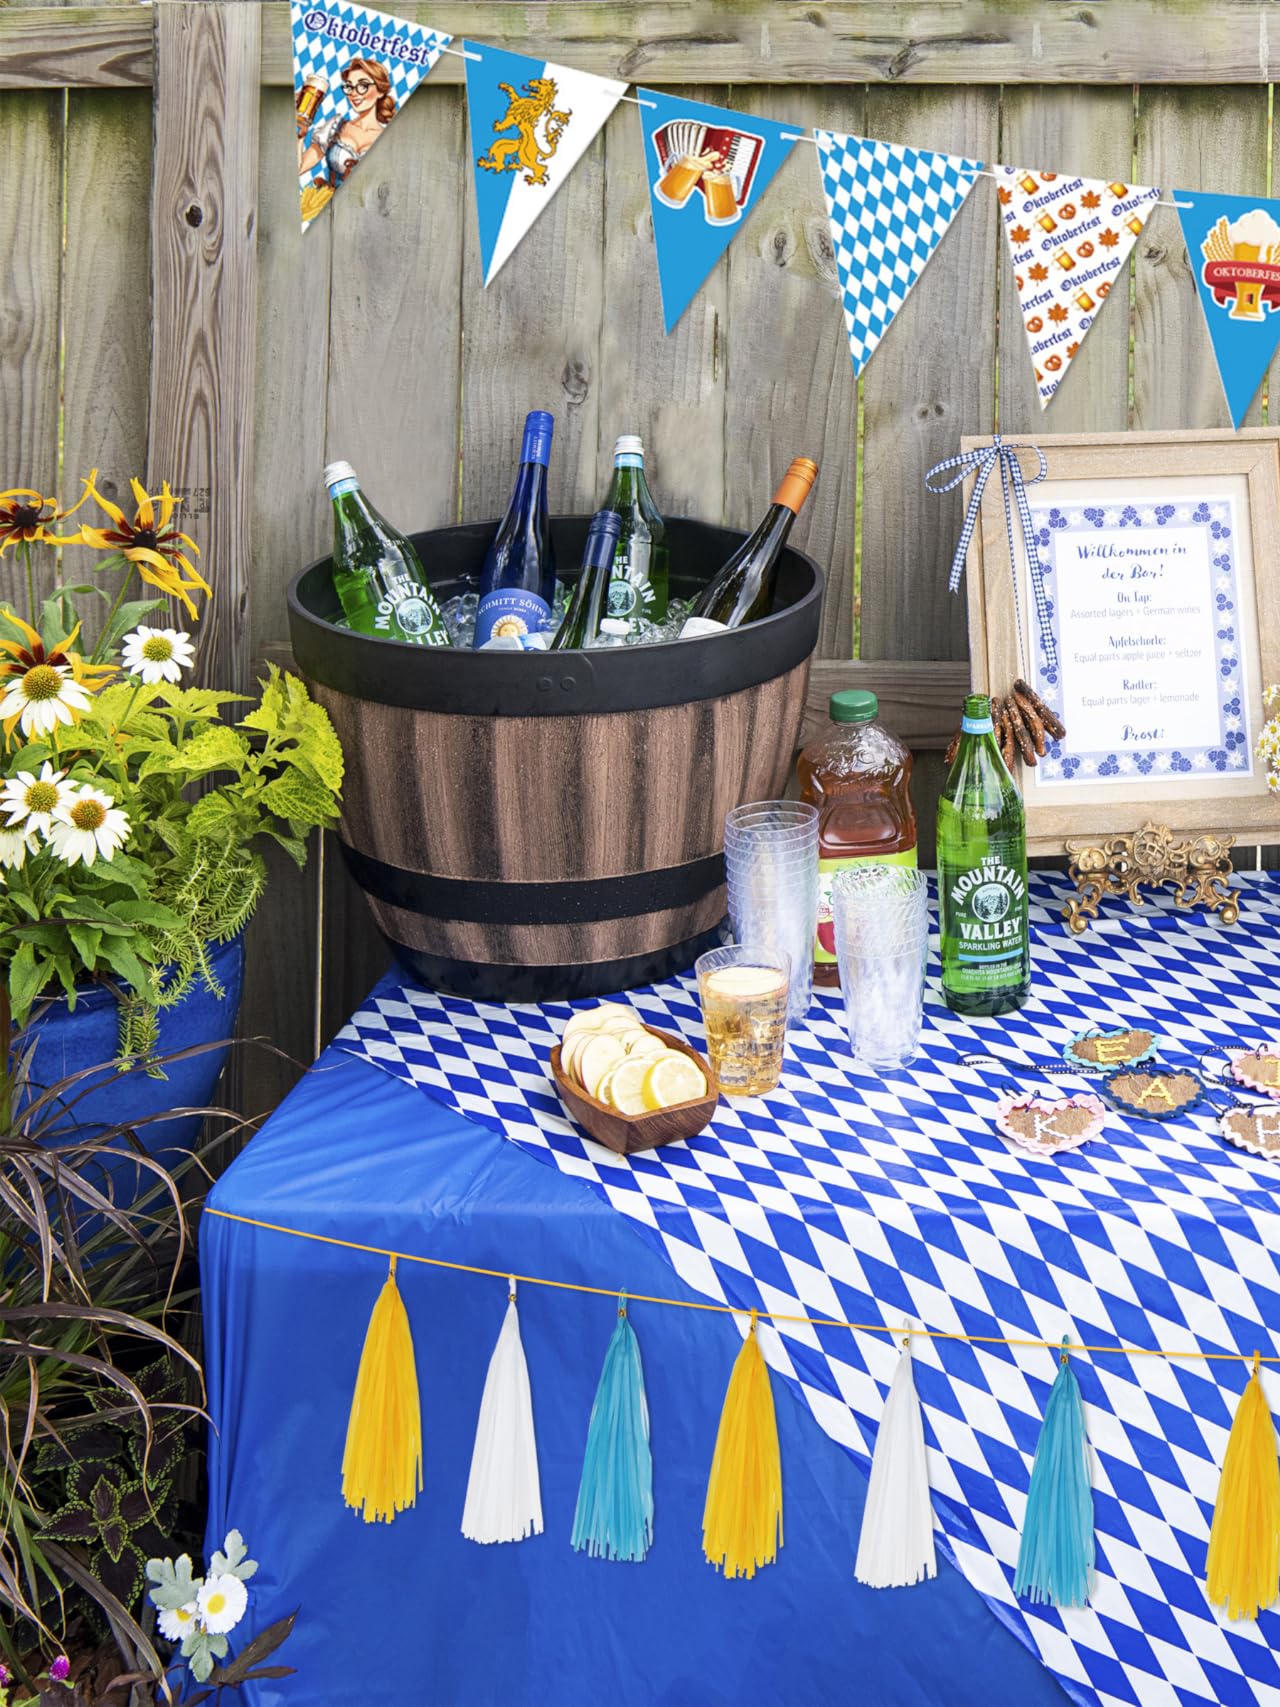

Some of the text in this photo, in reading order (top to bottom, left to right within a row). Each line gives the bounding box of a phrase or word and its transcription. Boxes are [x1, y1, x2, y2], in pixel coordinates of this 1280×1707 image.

[304, 11, 430, 65] Oktoberfest
[1022, 178, 1083, 213] Oktoberfest
[1041, 216, 1101, 251] Oktoberfest
[1060, 257, 1120, 292] Oktoberfest
[1077, 542, 1186, 560] Willkommen in
[1102, 563, 1163, 580] der Bar!
[1117, 591, 1130, 603] On
[374, 582, 441, 631] MOUNTAIN
[478, 598, 518, 617] SCHMITT
[1071, 608, 1107, 619] Assorted
[1109, 607, 1134, 620] lagers
[1143, 606, 1176, 617] German
[1177, 604, 1201, 615] wines
[1108, 634, 1167, 649] Apfelschorle:
[1074, 652, 1097, 664] Equal
[1099, 650, 1120, 663] parts
[1122, 648, 1145, 662] apple
[1146, 647, 1166, 662] juice
[1122, 679, 1158, 691] Radler:
[1081, 695, 1105, 708] Equal
[1106, 694, 1128, 707] parts
[1130, 693, 1151, 707] lager
[1160, 690, 1200, 704] lemonade
[1121, 724, 1165, 741] Prost!
[980, 855, 1001, 866] THE
[950, 865, 1026, 906] MOUNTAIN
[959, 917, 1023, 941] VALLEY
[959, 936, 1024, 952] SPARKLING WATER
[1094, 1037, 1133, 1064] E
[1137, 1078, 1177, 1107] A
[1032, 1113, 1072, 1143] K
